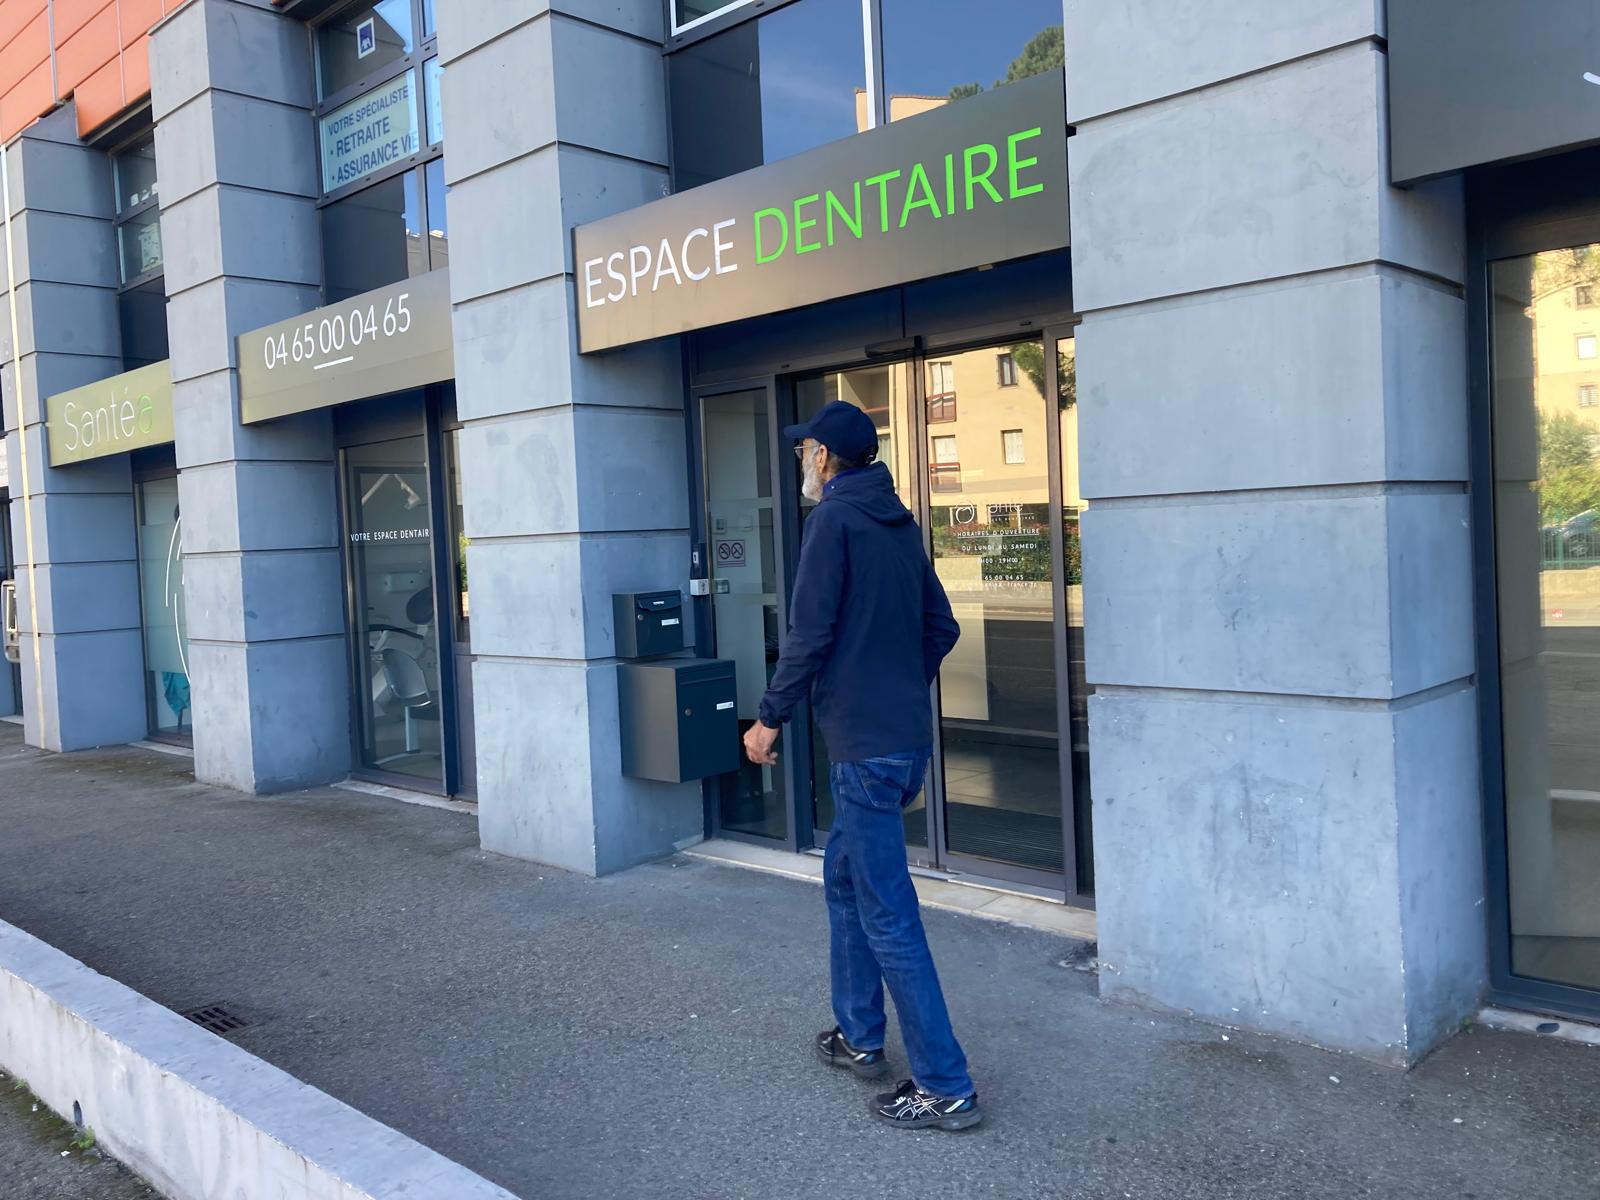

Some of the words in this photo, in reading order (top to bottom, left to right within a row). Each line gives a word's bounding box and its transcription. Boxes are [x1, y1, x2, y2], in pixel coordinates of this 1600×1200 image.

[328, 113, 355, 136] VOTRE
[355, 85, 409, 122] SPÉCIALISTE
[336, 116, 390, 157] RETRAITE
[336, 139, 399, 183] ASSURANCE
[584, 217, 738, 309] ESPACE
[752, 126, 1044, 265] DENTAIRE
[264, 332, 288, 370] 04
[292, 323, 315, 362] 65
[319, 314, 345, 354] 00
[349, 304, 378, 346] 04
[383, 292, 411, 337] 65
[350, 533, 371, 542] VOTRE
[374, 530, 398, 540] ESPACE
